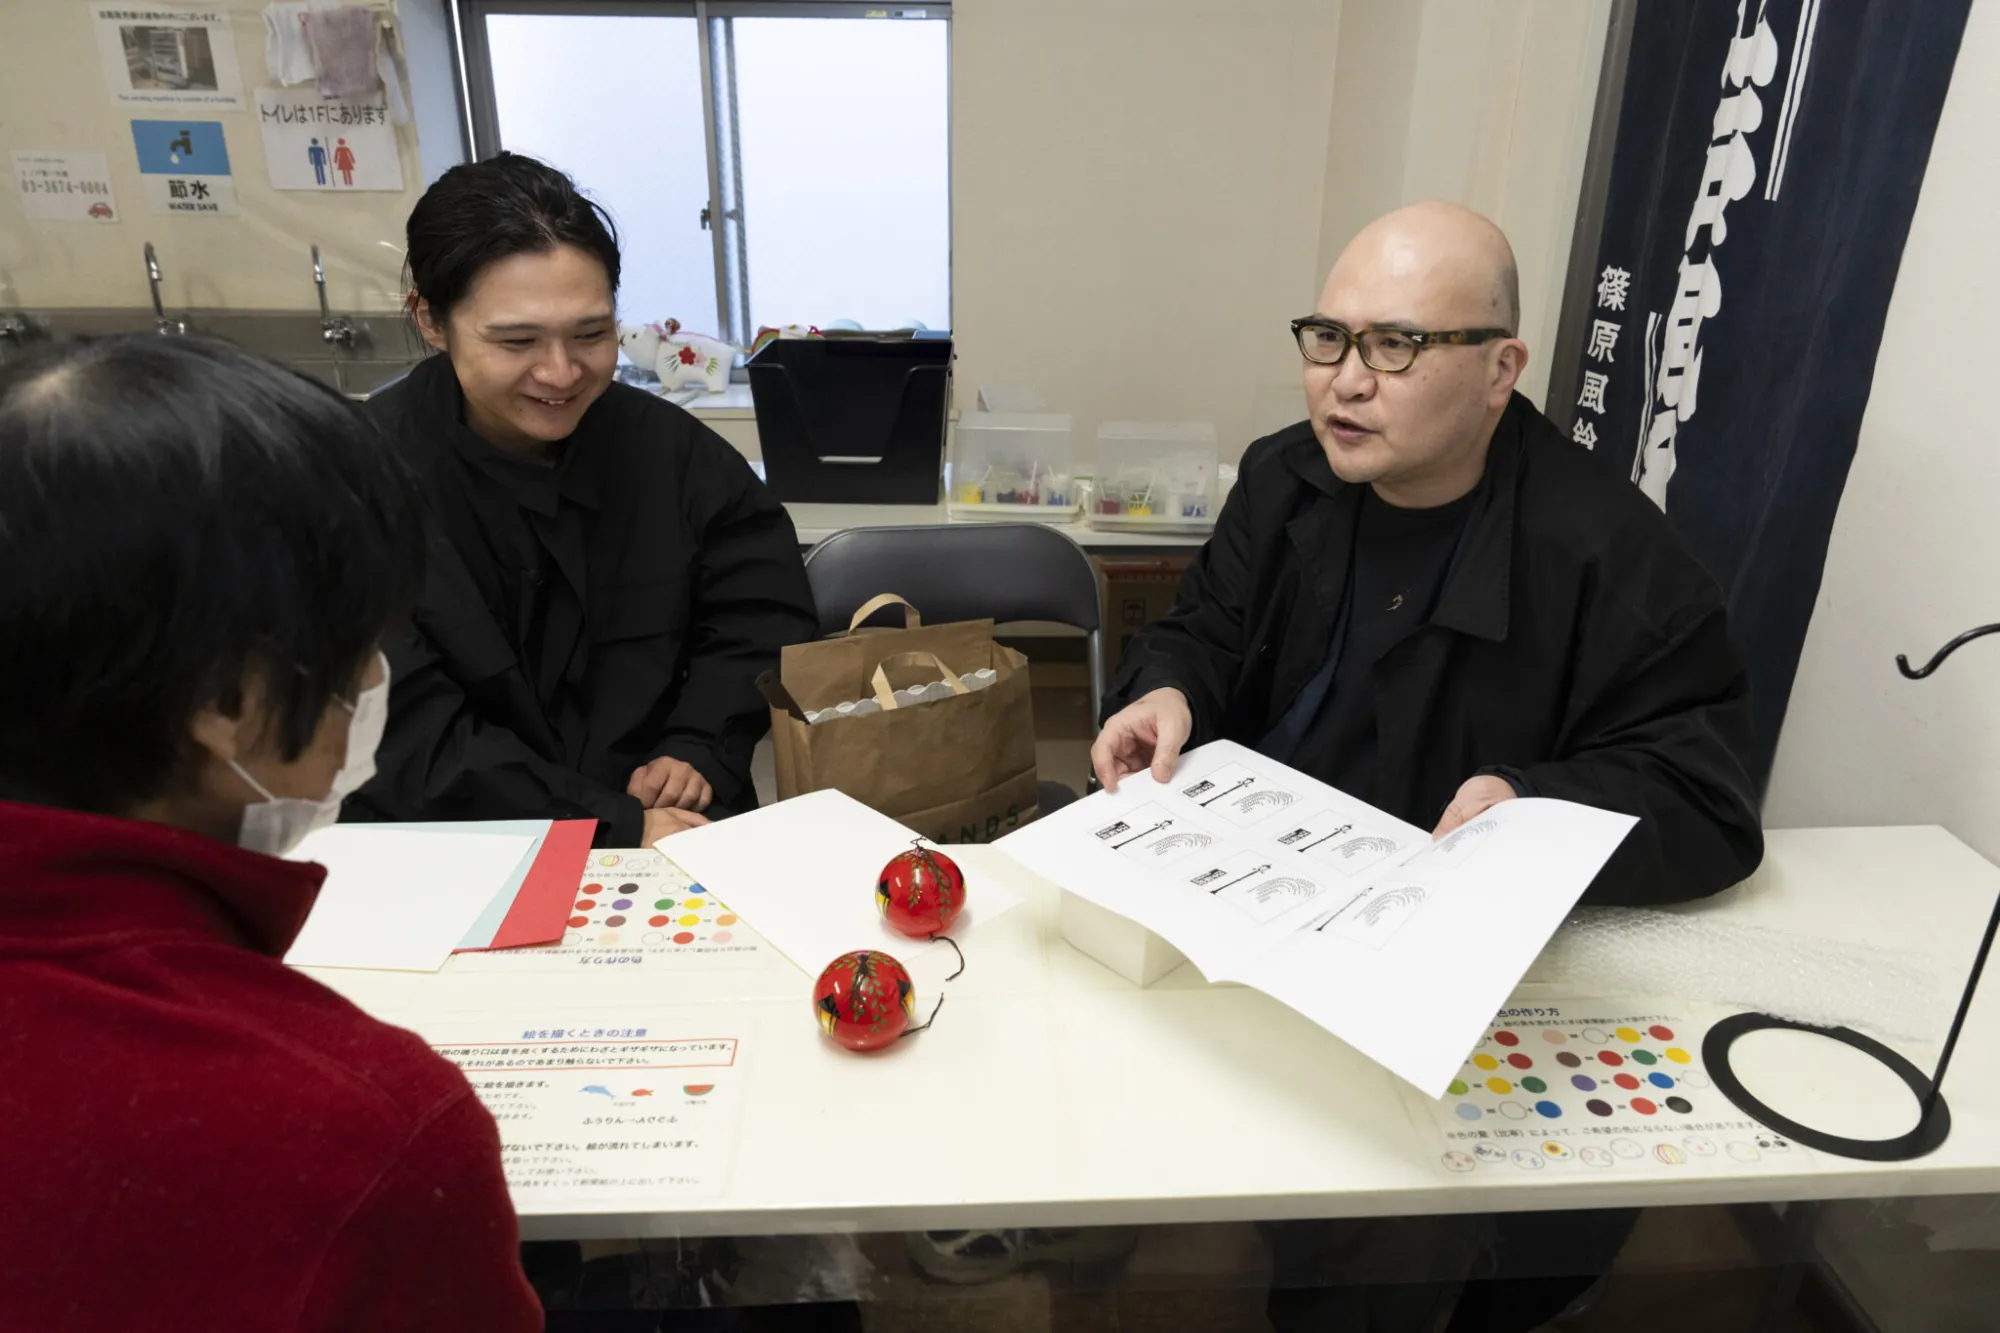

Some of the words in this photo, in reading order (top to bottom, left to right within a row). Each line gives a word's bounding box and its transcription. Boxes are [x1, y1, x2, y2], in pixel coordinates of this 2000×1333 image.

[260, 103, 388, 126] トイレは1Fにあります
[168, 179, 210, 200] 節水
[168, 202, 197, 211] WATER
[198, 202, 219, 212] SAVE
[1572, 264, 1631, 451] 篠原風鈴
[578, 956, 642, 964] 色の作り方
[522, 1028, 648, 1040] 絵を描くときの注意
